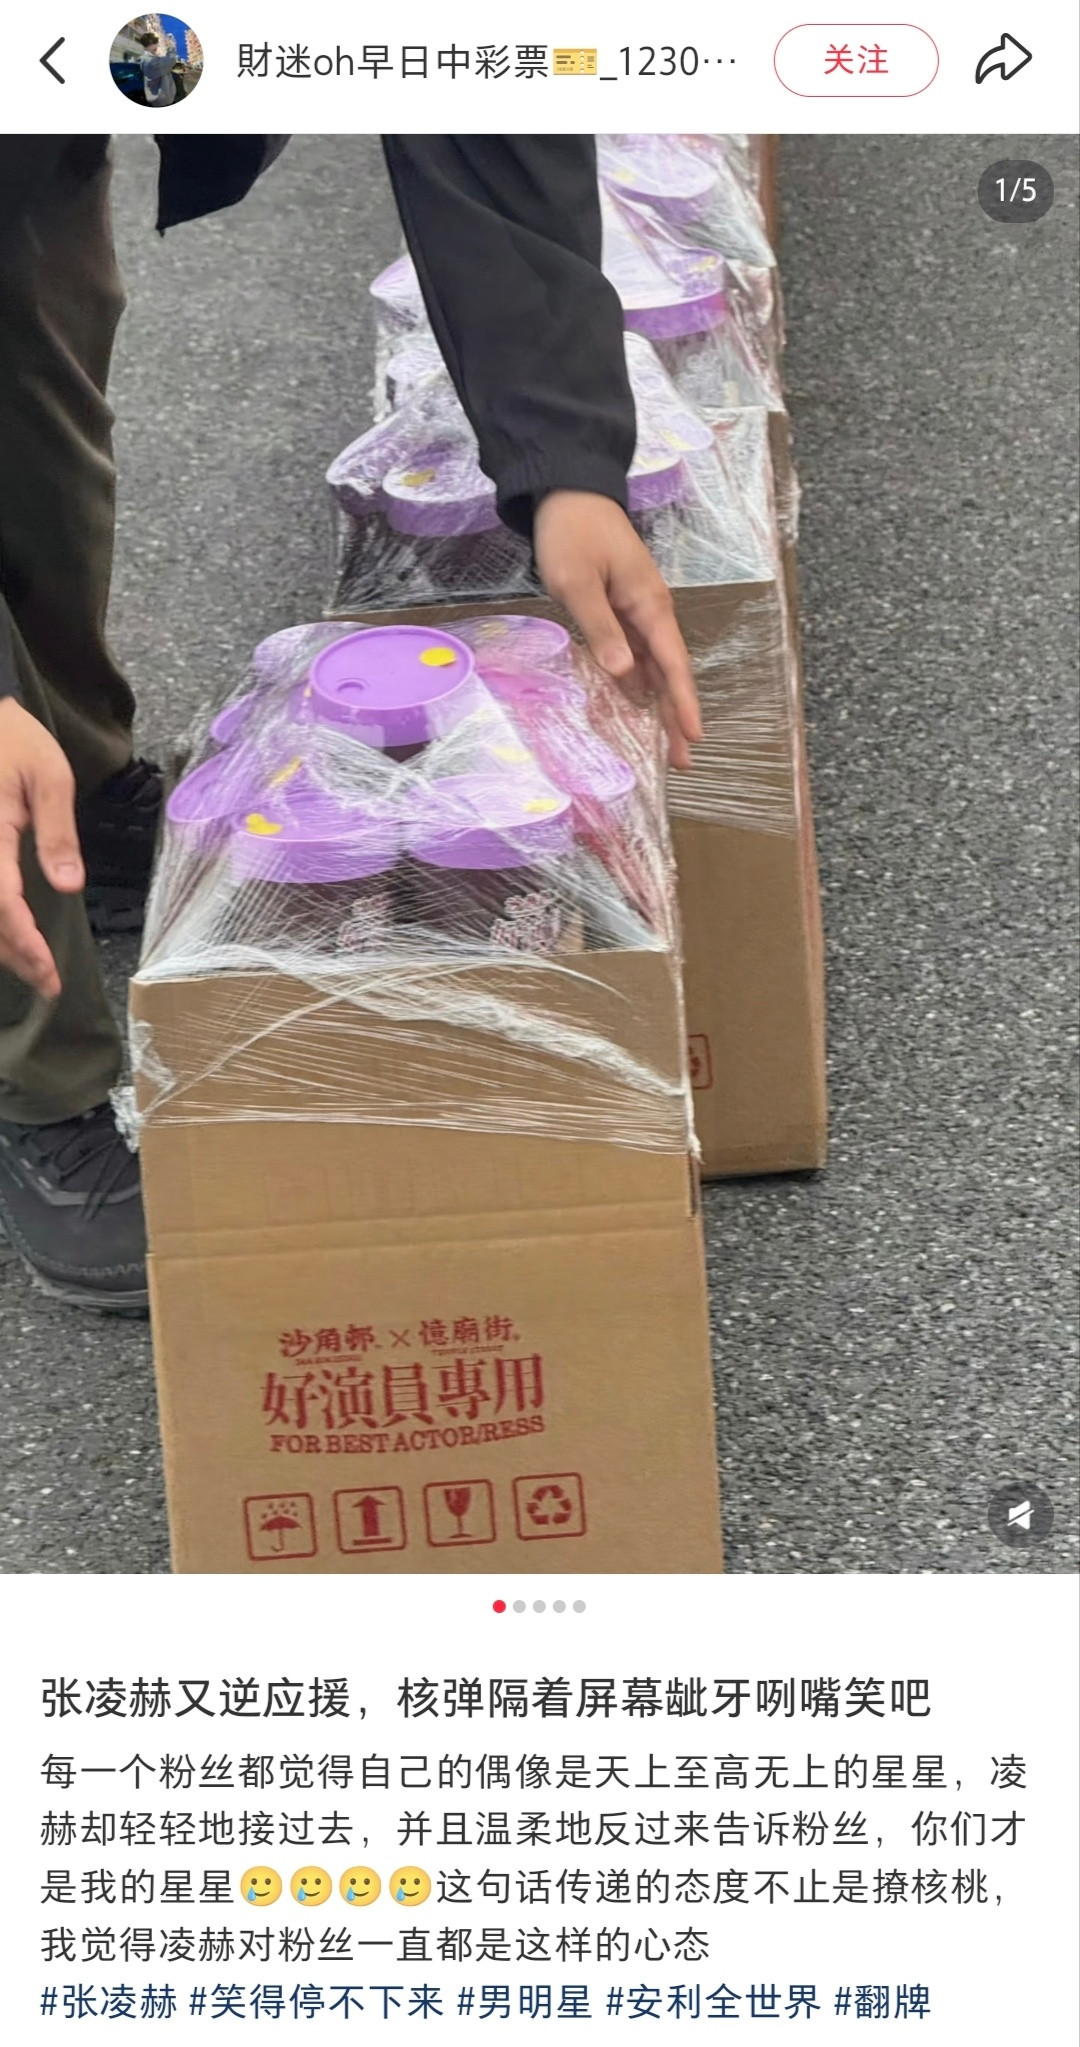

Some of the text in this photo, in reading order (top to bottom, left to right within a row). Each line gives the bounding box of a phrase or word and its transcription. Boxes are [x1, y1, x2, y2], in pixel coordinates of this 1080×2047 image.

[261, 1352, 544, 1430] 好演員專用
[269, 1414, 546, 1454] FOR BEST ACTOR/RESS
